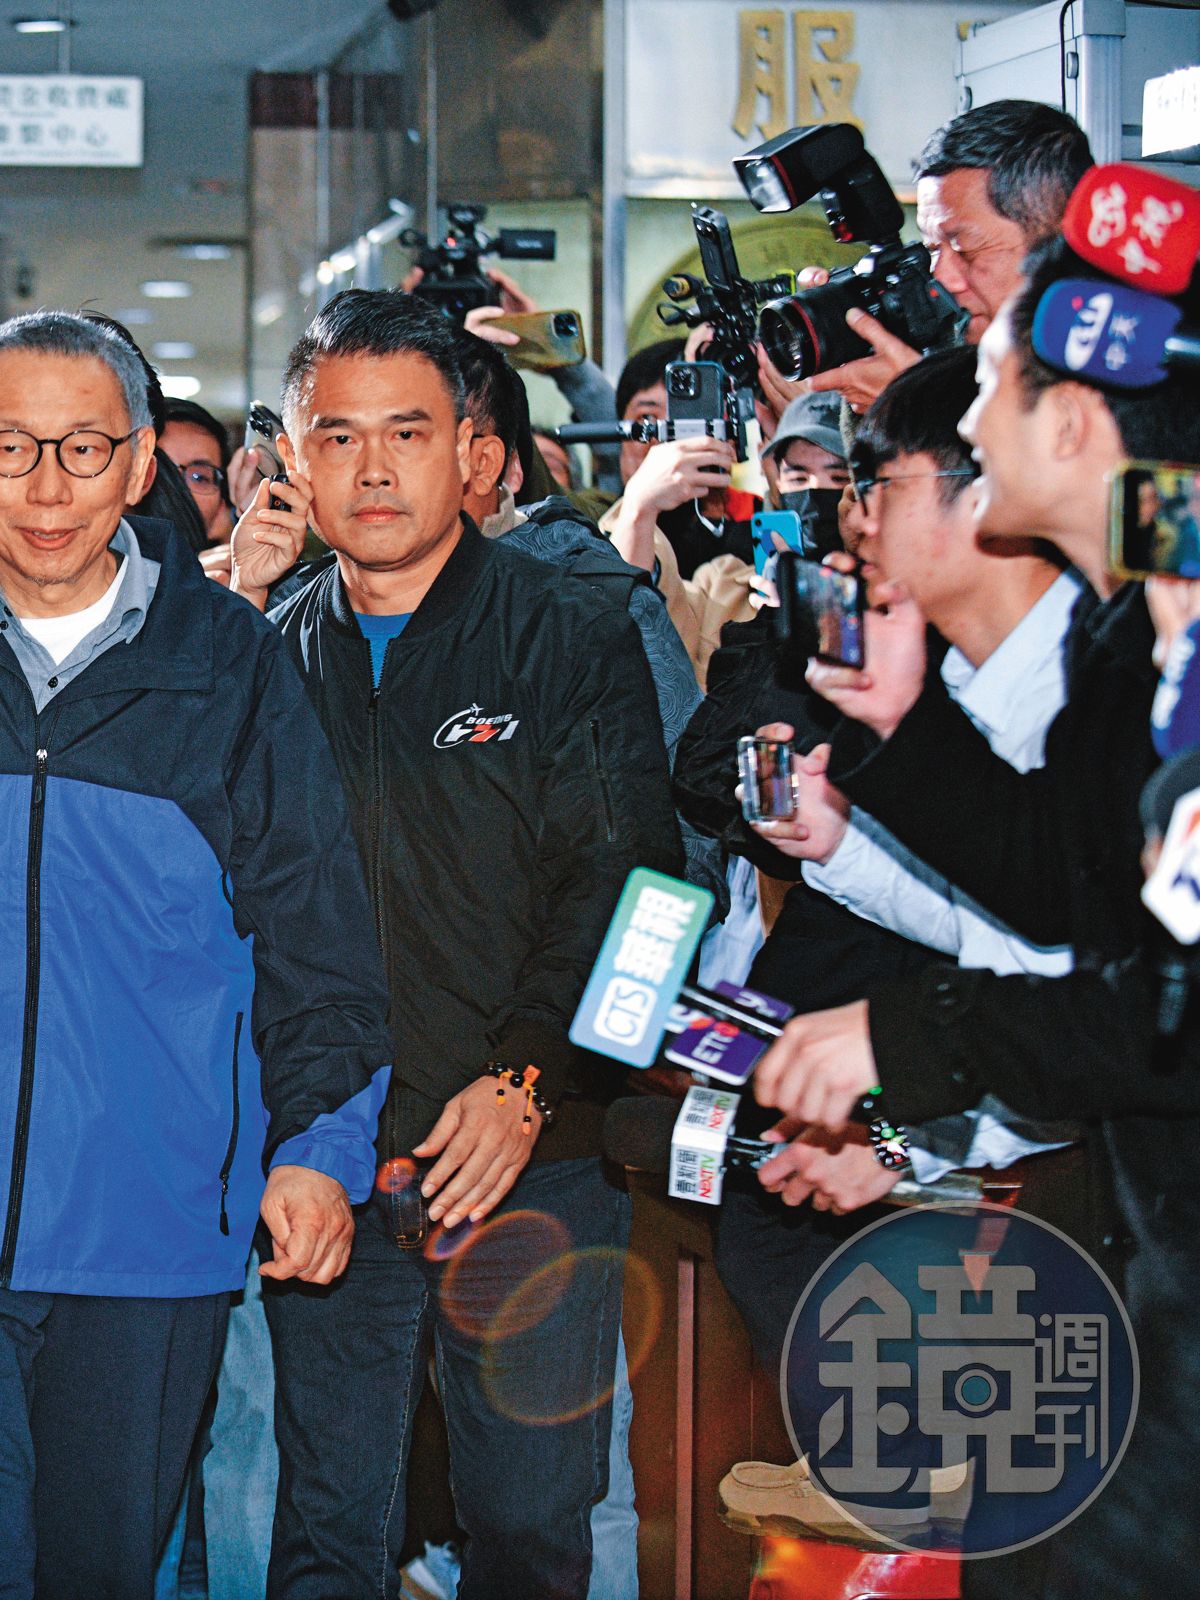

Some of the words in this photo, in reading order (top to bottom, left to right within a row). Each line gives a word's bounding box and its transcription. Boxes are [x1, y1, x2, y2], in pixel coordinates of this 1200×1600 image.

[733, 11, 864, 141] 服
[613, 885, 697, 986] 華視
[603, 985, 649, 1038] CTS
[675, 1149, 698, 1193] 壹新聞
